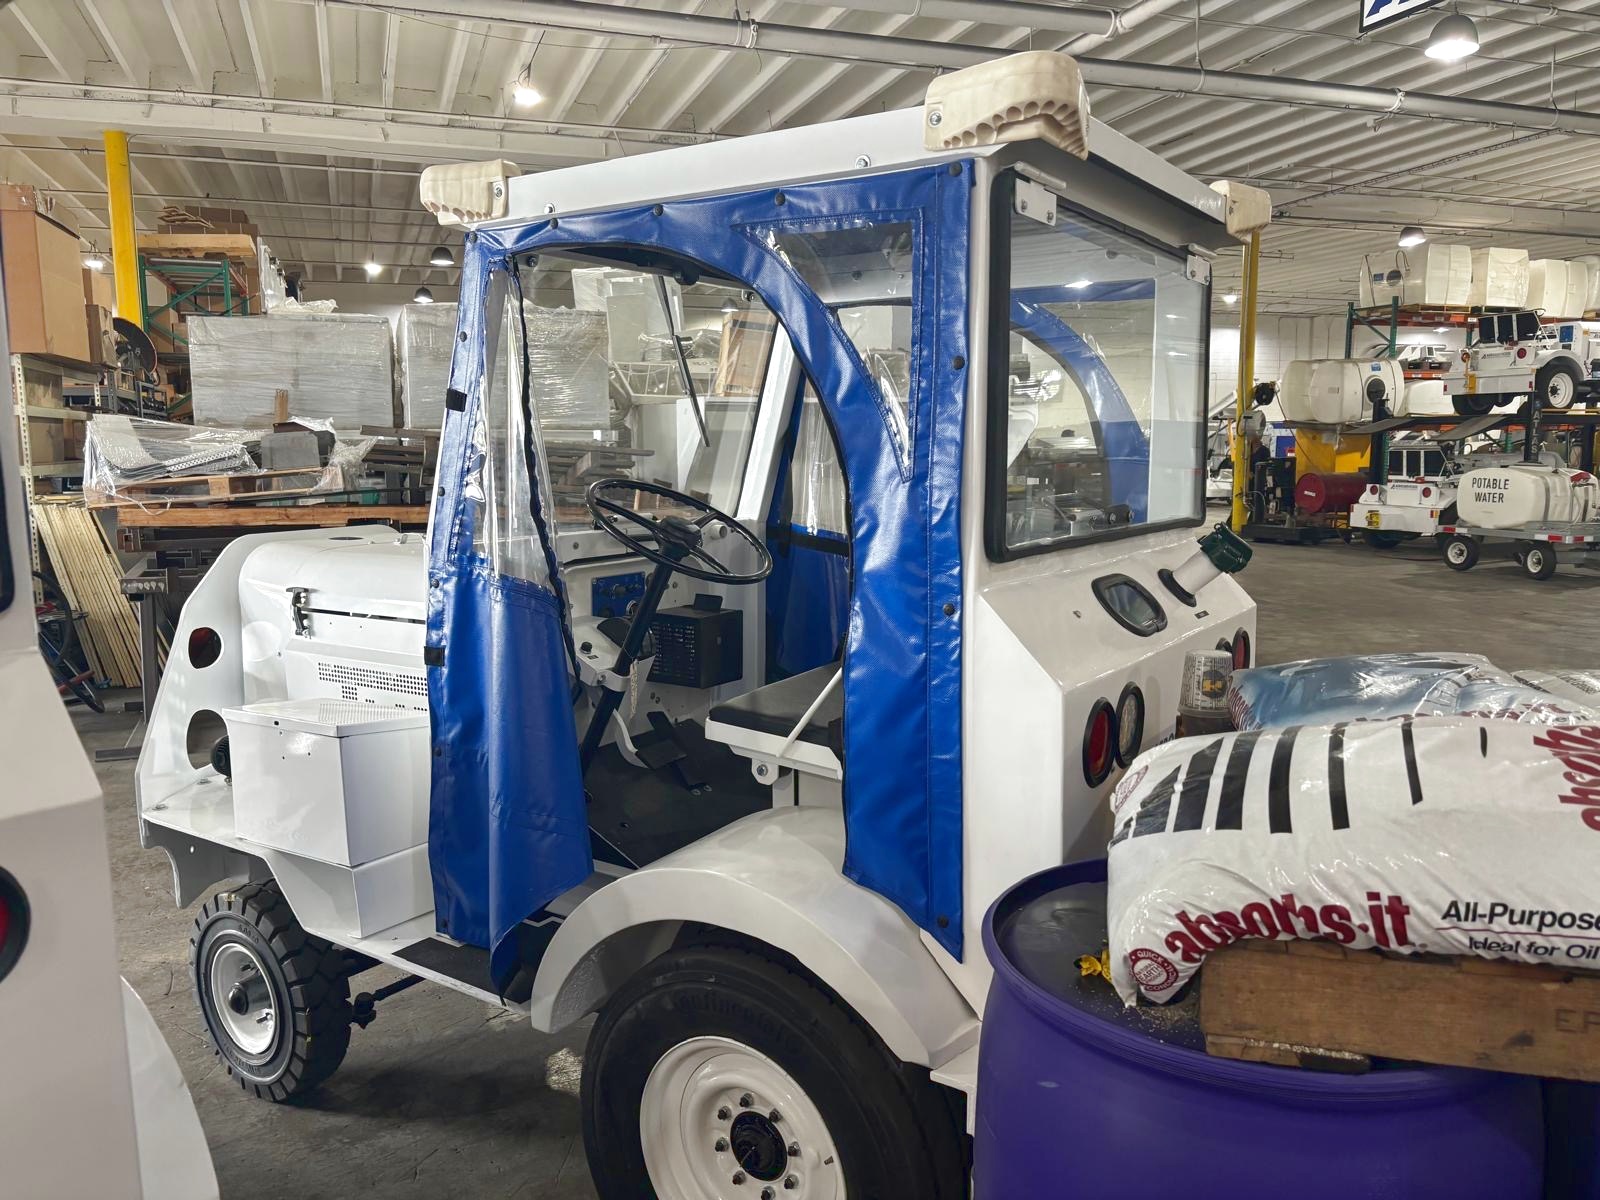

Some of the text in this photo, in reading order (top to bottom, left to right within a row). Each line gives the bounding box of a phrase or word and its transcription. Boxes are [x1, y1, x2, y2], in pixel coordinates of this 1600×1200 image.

[1531, 410, 1540, 454] ATLAS
[1471, 477, 1510, 490] POTABLE
[1474, 492, 1505, 503] WATER
[1137, 950, 1164, 964] QUICK
[1526, 941, 1561, 956] for
[1566, 944, 1600, 960] Oil
